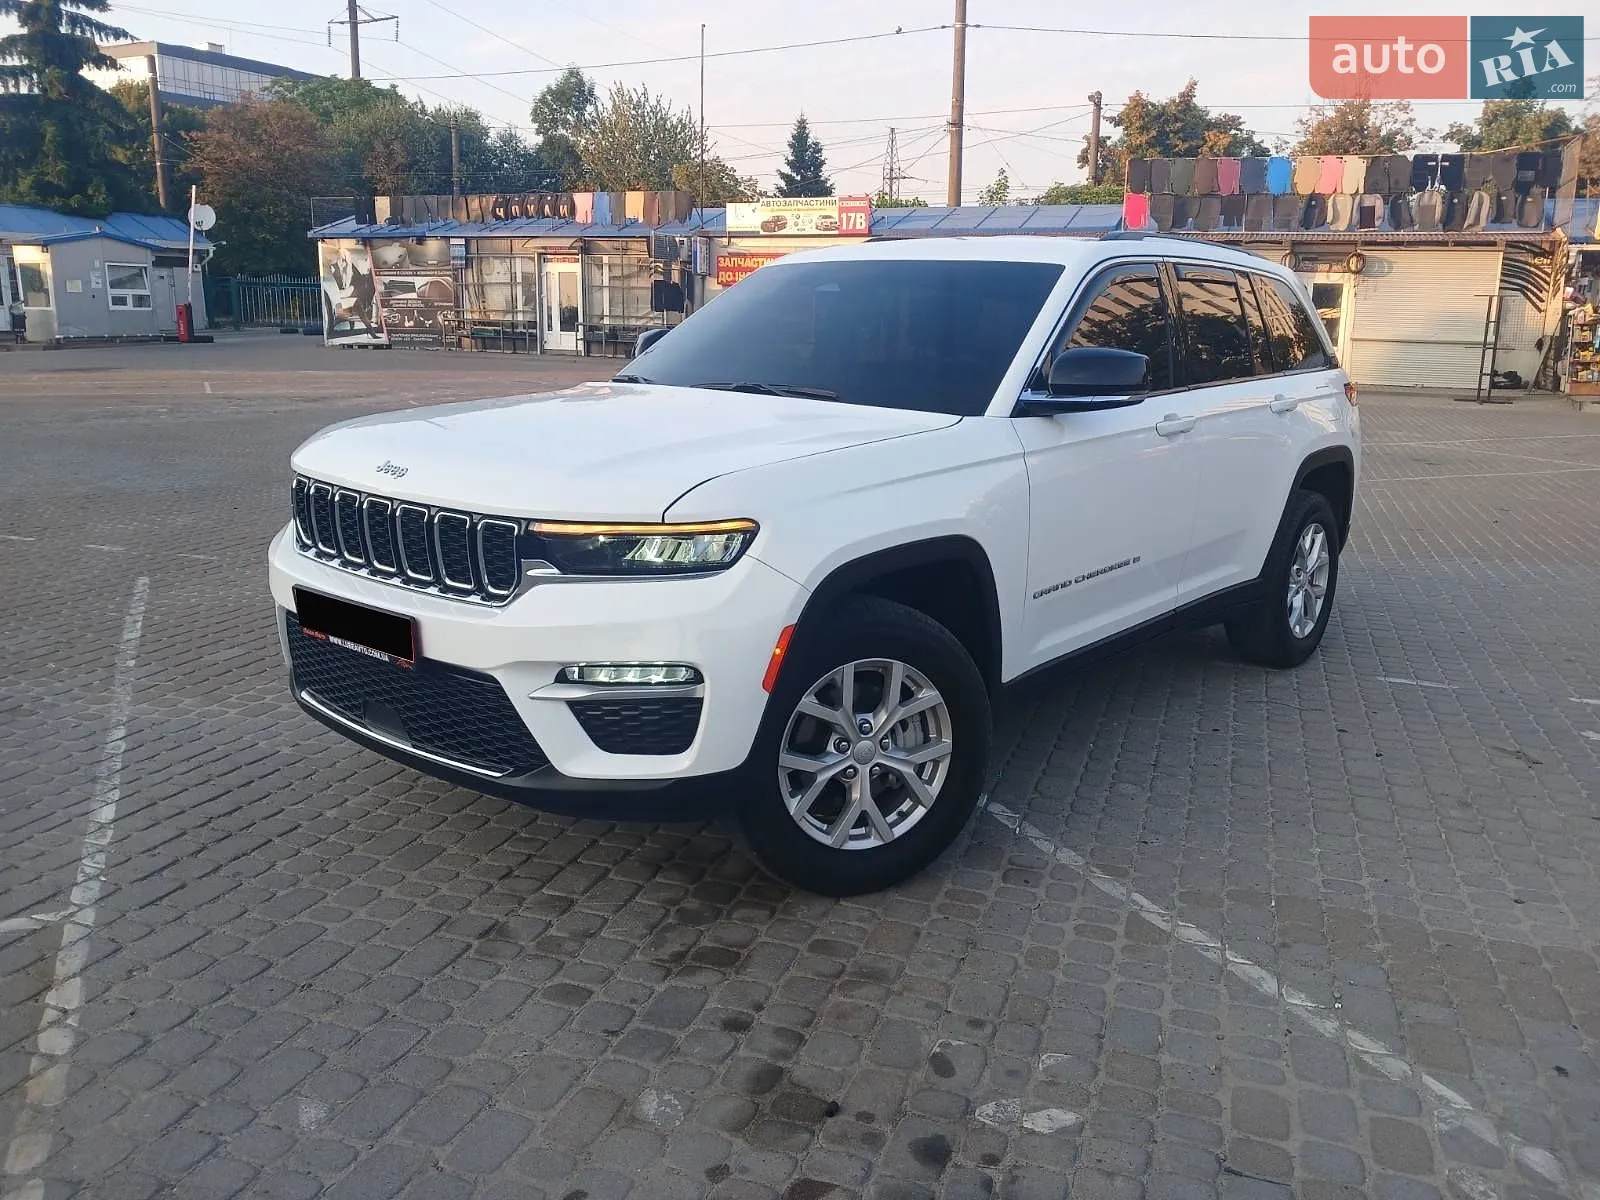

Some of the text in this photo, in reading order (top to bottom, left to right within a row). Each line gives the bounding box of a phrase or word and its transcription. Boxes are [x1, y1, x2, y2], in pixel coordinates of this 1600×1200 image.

[760, 199, 837, 208] АВТОЗАПЧАСТИНИ
[718, 271, 734, 283] ДО
[375, 460, 408, 480] Jeep
